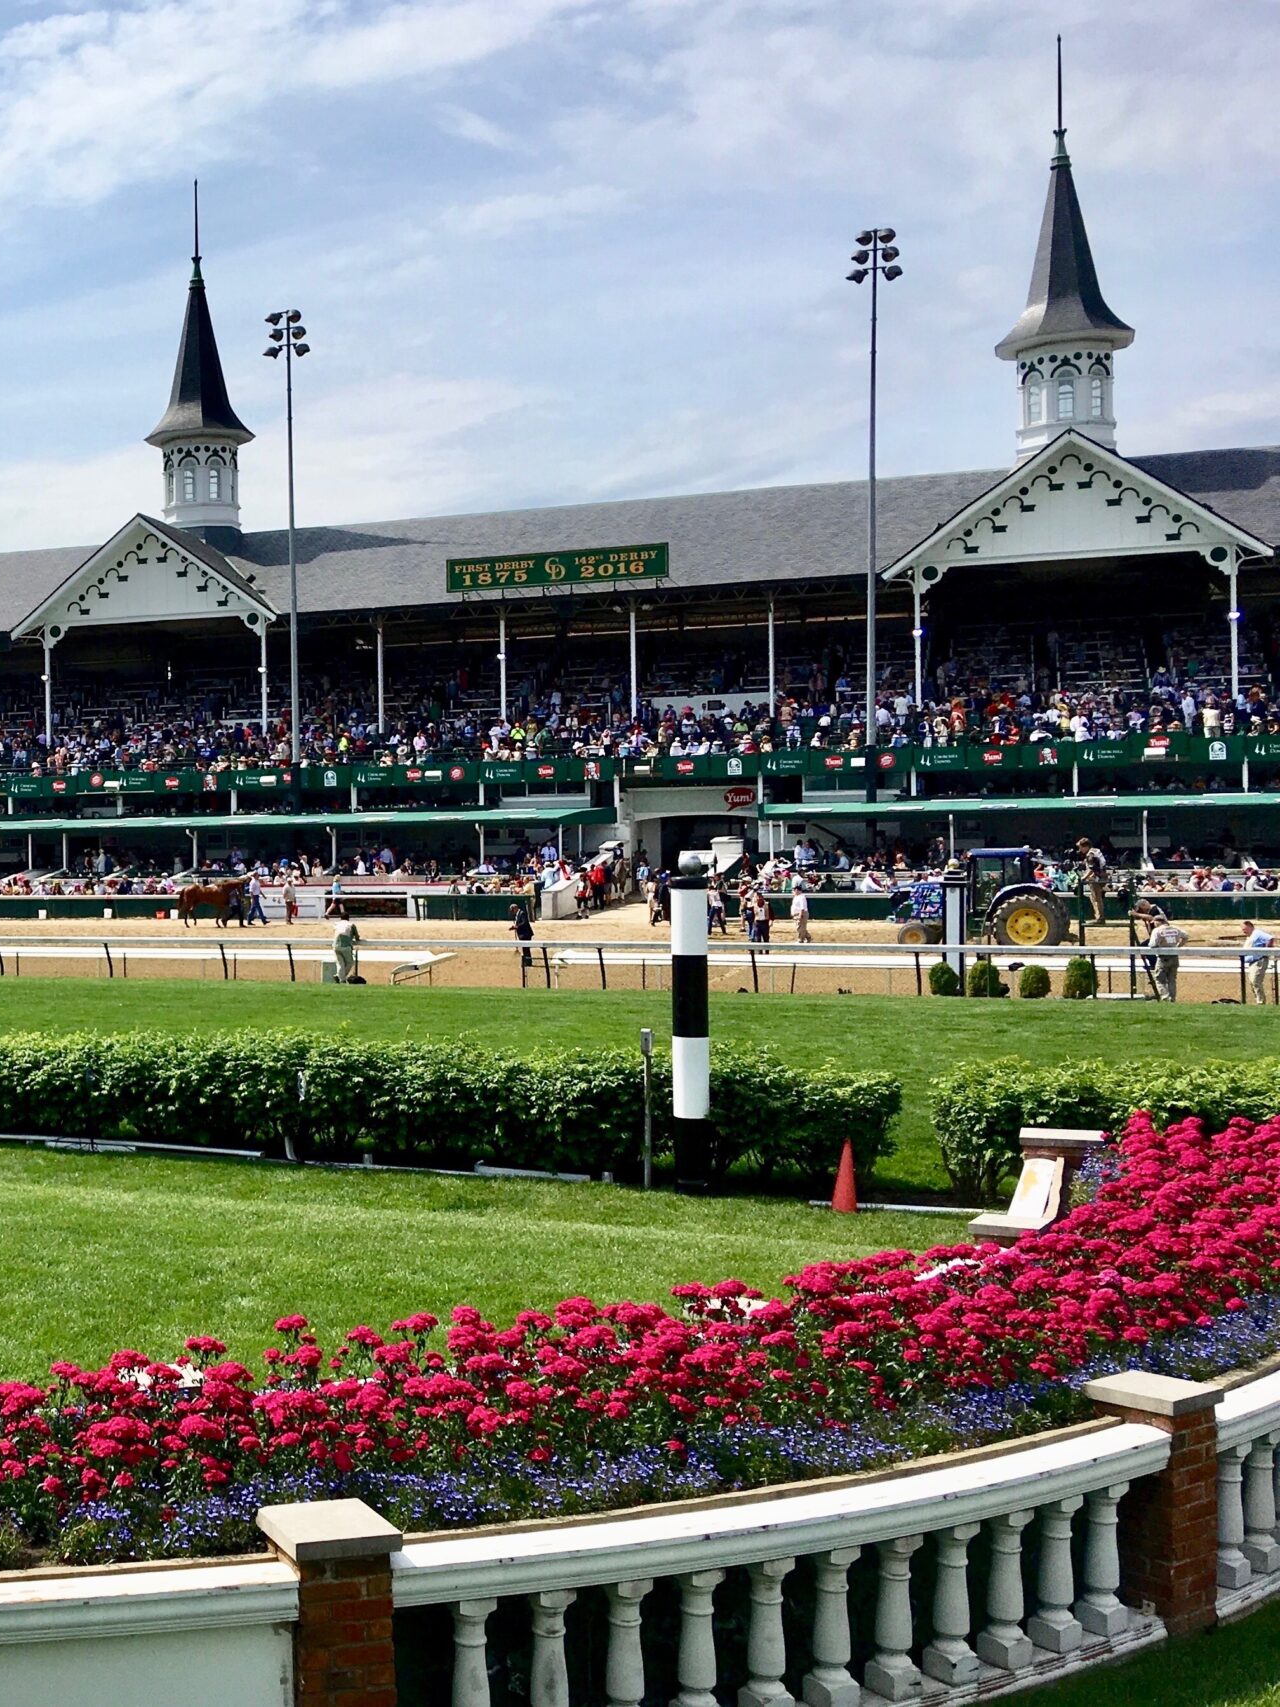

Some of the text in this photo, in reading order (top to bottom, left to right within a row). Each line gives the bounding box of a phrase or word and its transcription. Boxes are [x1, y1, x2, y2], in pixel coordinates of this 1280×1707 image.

[609, 550, 658, 561] DERBY
[454, 560, 535, 574] FIRST DERBY
[580, 560, 645, 578] 2016
[462, 569, 527, 586] 1875
[983, 752, 1003, 761] Yum!
[726, 792, 753, 803] Yum!
